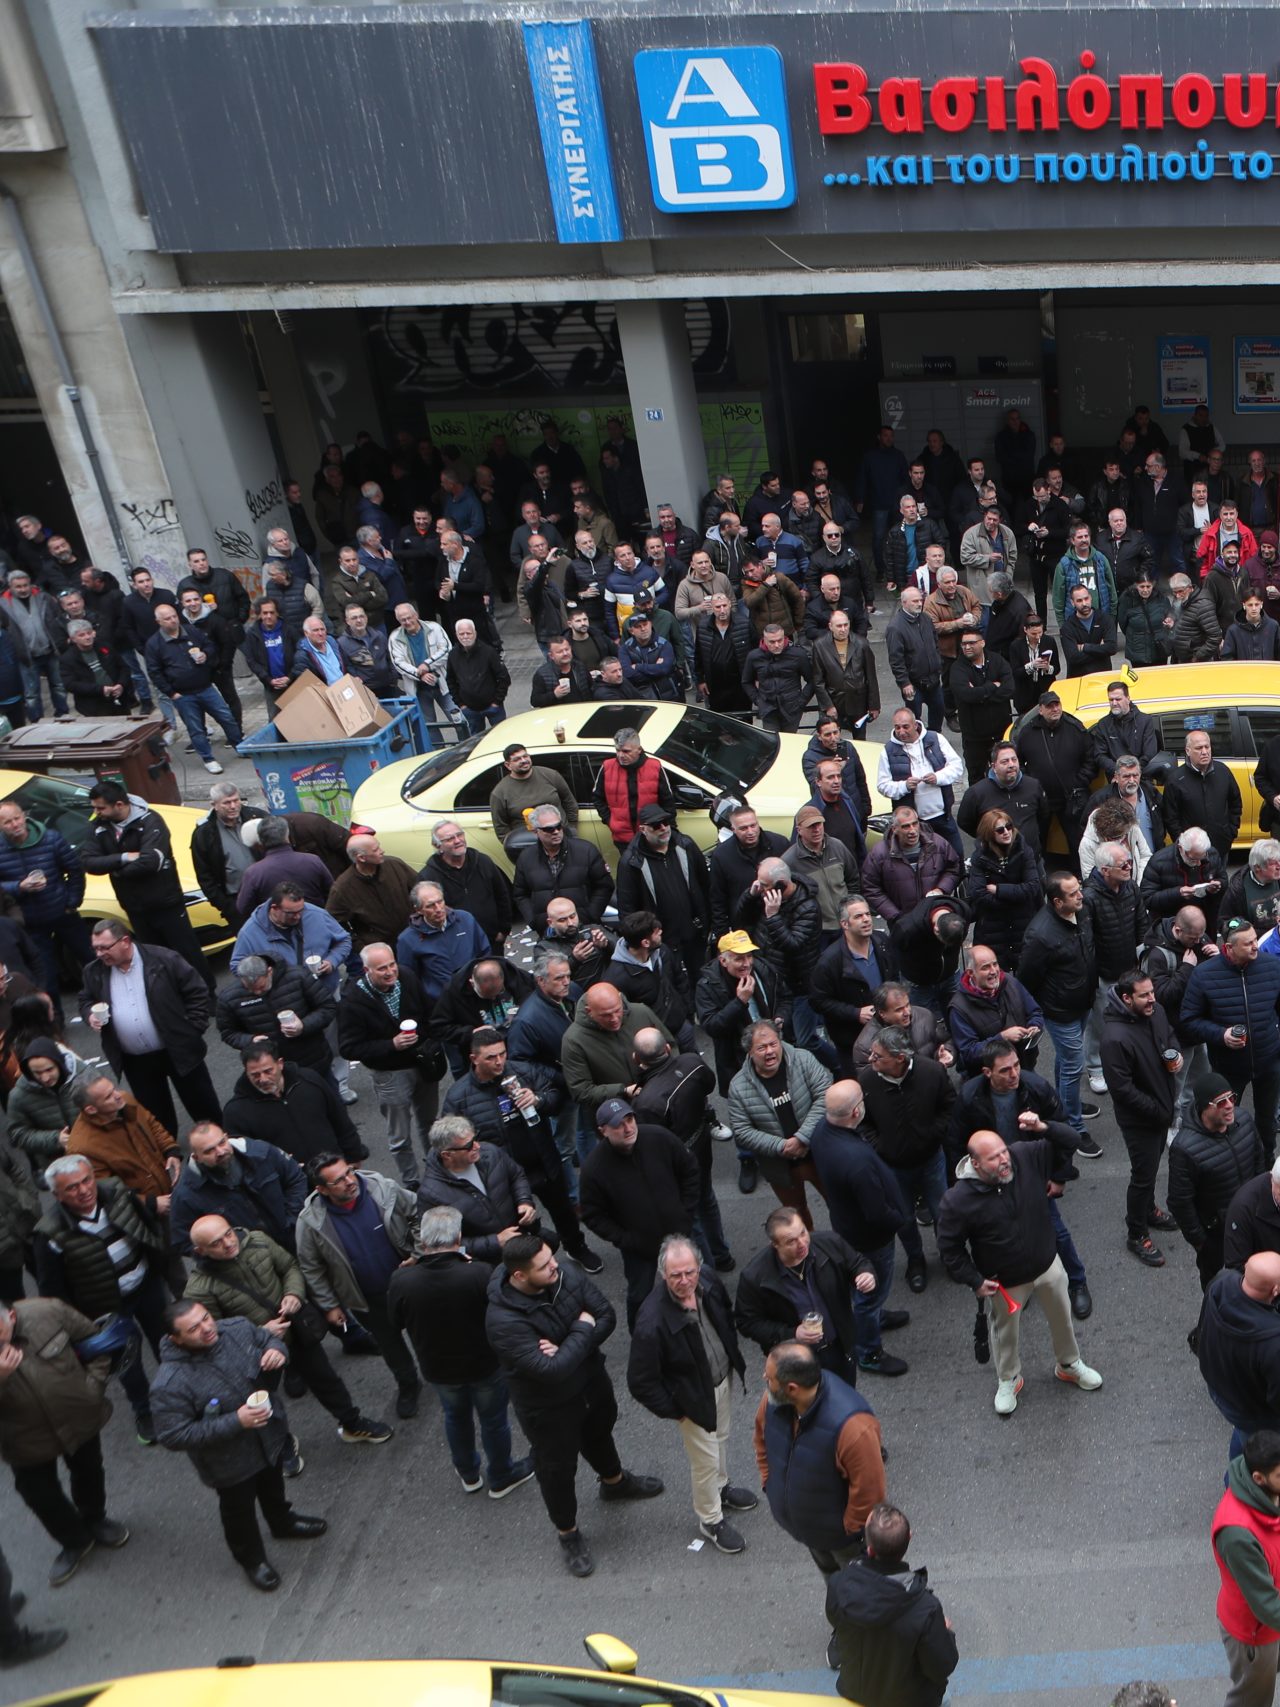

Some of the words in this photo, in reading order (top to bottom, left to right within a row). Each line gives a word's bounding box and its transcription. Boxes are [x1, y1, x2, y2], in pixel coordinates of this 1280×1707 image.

[547, 46, 595, 218] ΣΥΝΕΡΓΑΤΗΣ
[946, 153, 1020, 184] του
[1034, 139, 1214, 184] πουλιού
[1228, 150, 1273, 181] το
[650, 411, 660, 420] 24
[966, 396, 1001, 406] Smart
[1003, 396, 1031, 408] point
